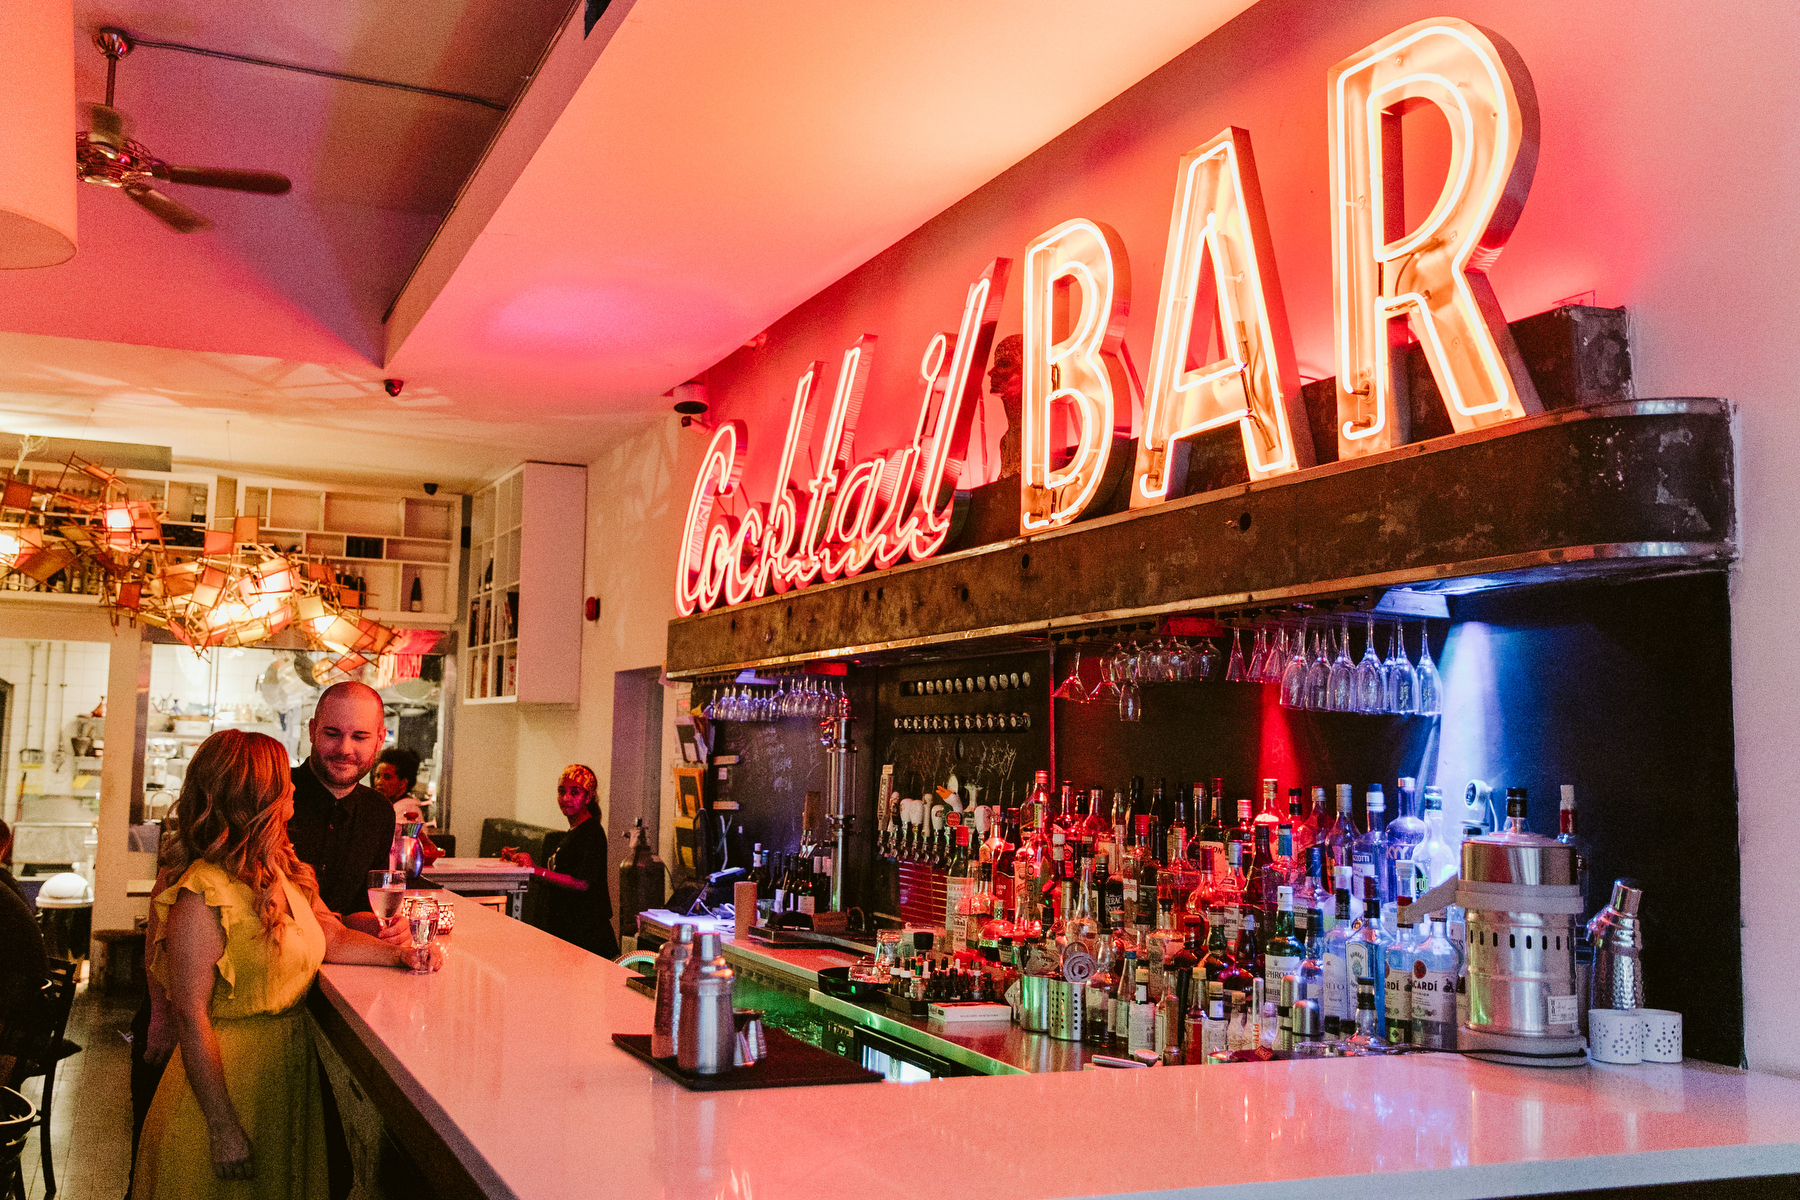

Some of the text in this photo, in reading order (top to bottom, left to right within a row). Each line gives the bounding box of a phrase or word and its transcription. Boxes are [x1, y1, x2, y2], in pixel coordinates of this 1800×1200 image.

[1020, 16, 1542, 536] BAR
[1386, 845, 1409, 859] KYY
[1385, 980, 1400, 991] RDÍ
[1412, 980, 1438, 992] CARDÍ
